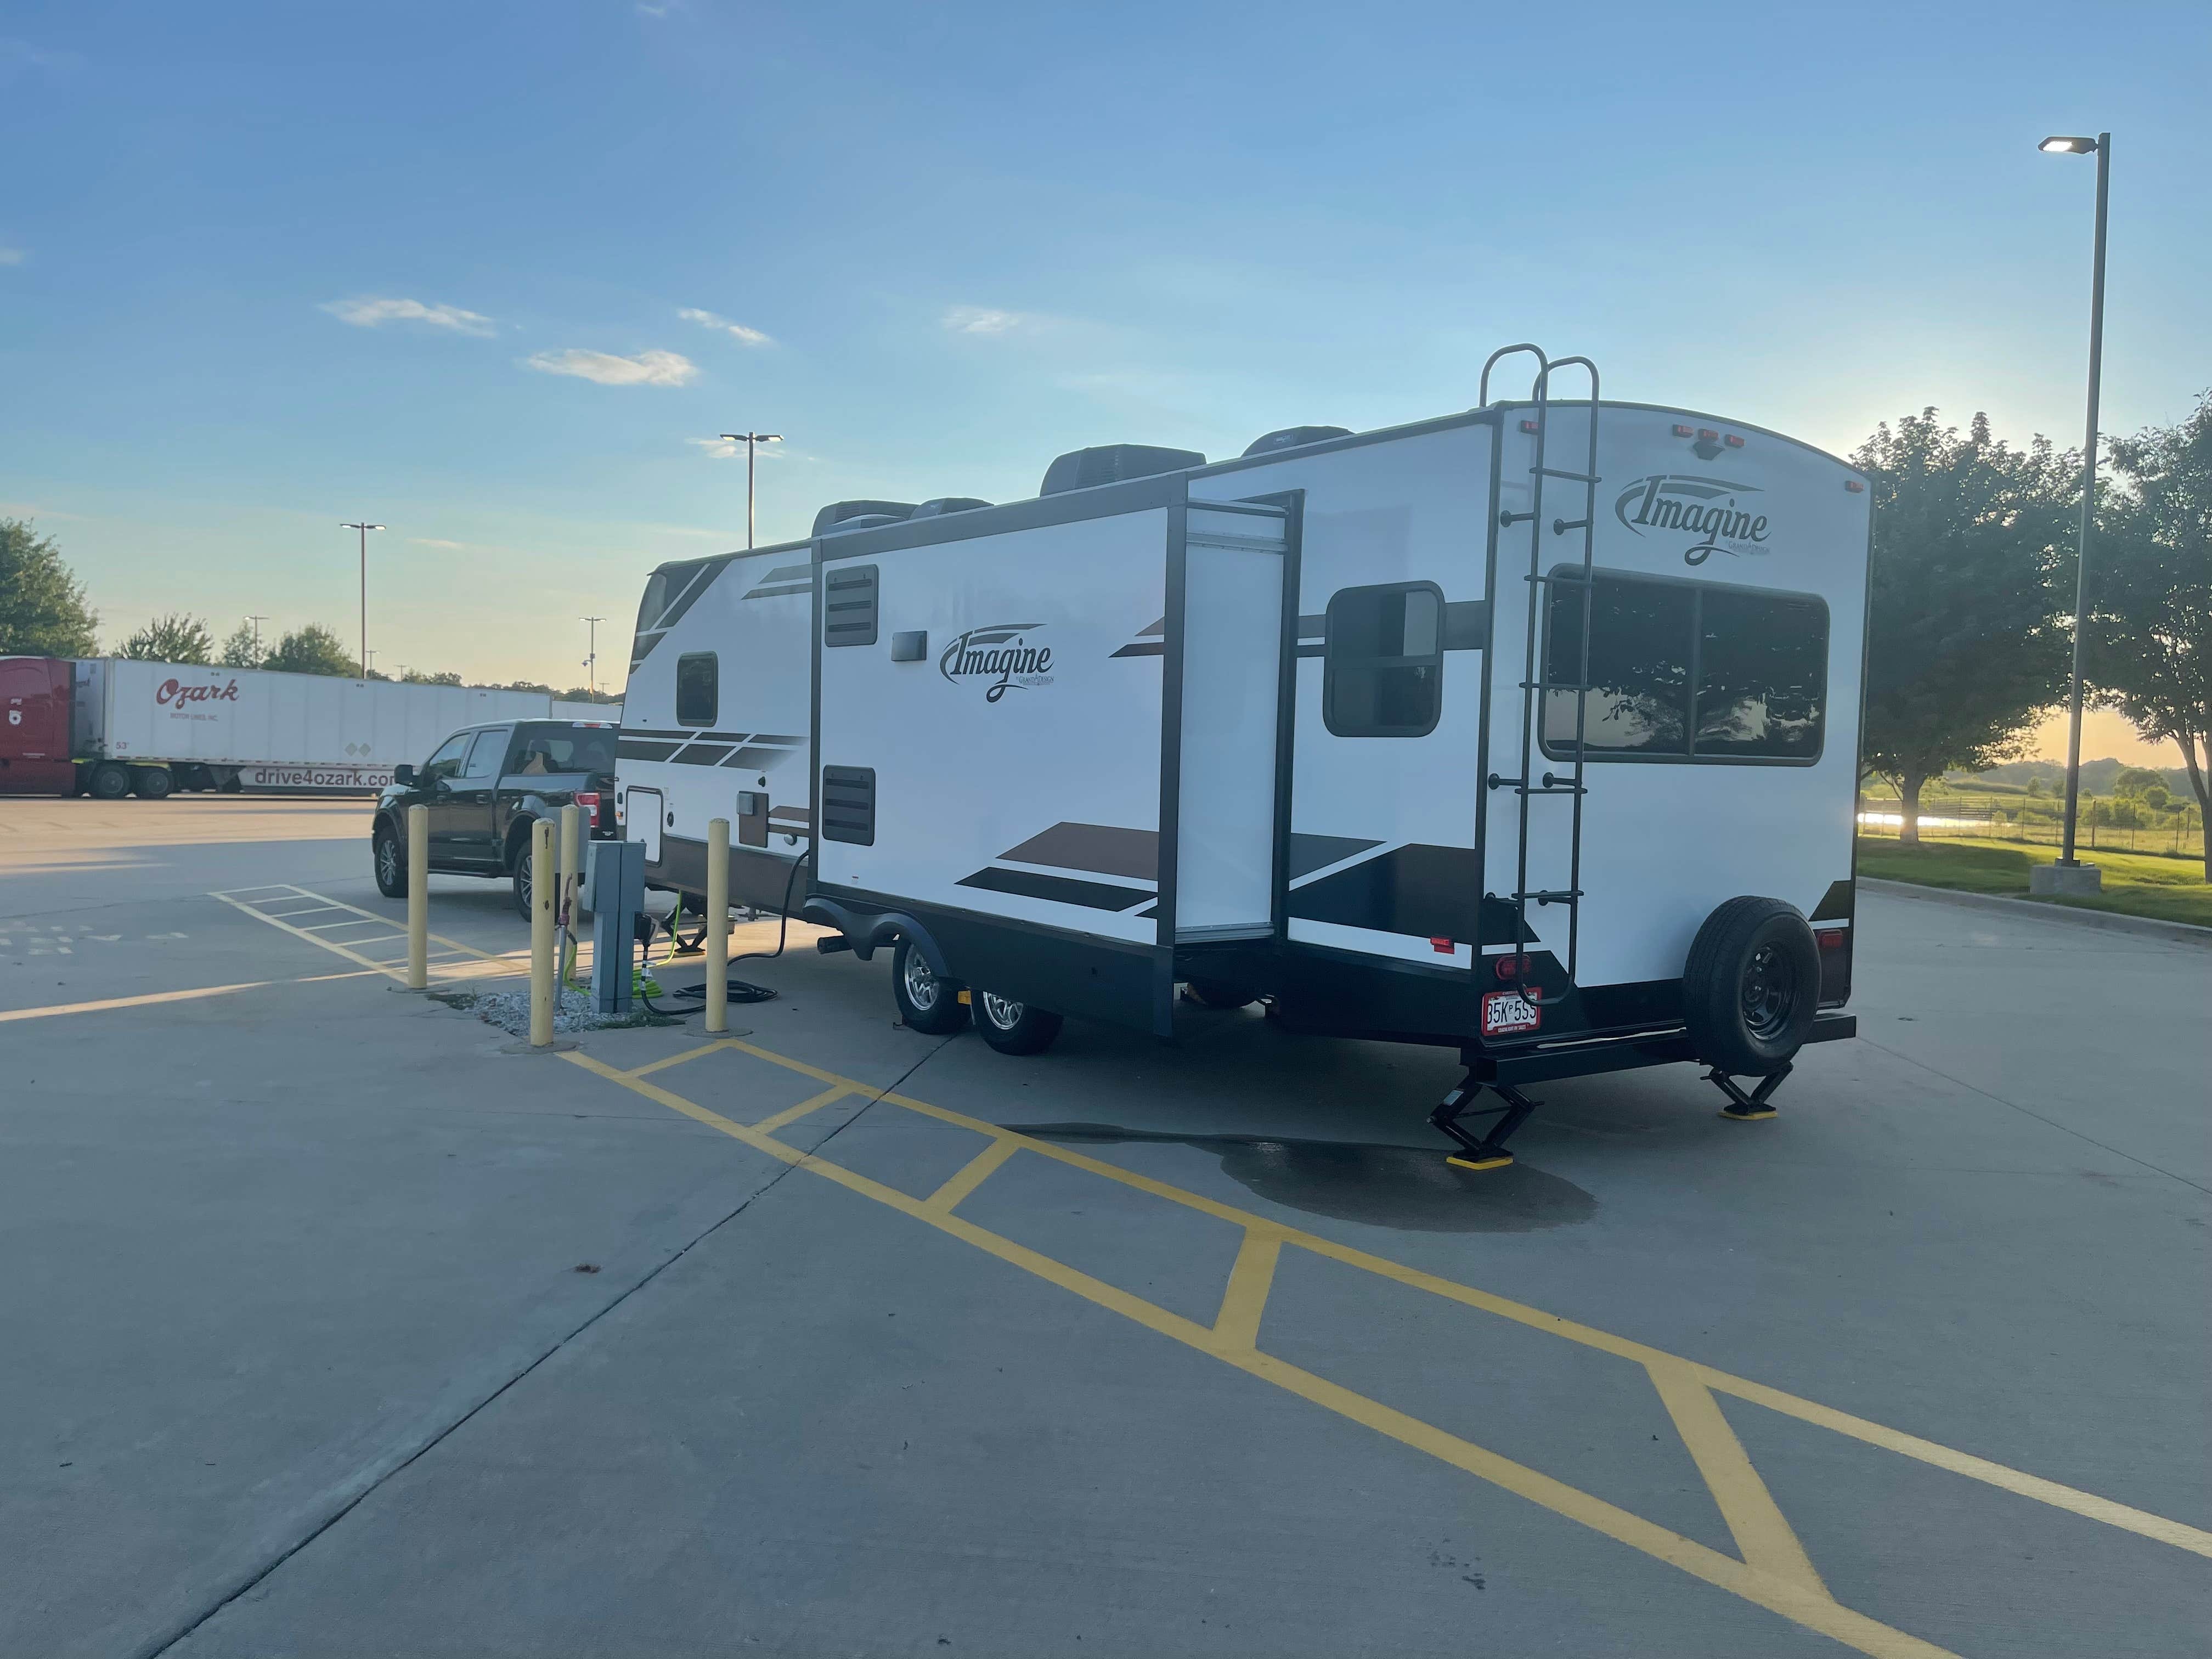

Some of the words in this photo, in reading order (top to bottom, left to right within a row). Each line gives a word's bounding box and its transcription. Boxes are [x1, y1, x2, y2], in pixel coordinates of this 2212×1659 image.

[1631, 475, 1771, 566] Imagine
[156, 678, 239, 709] Ozark
[950, 630, 1054, 703] Imagine
